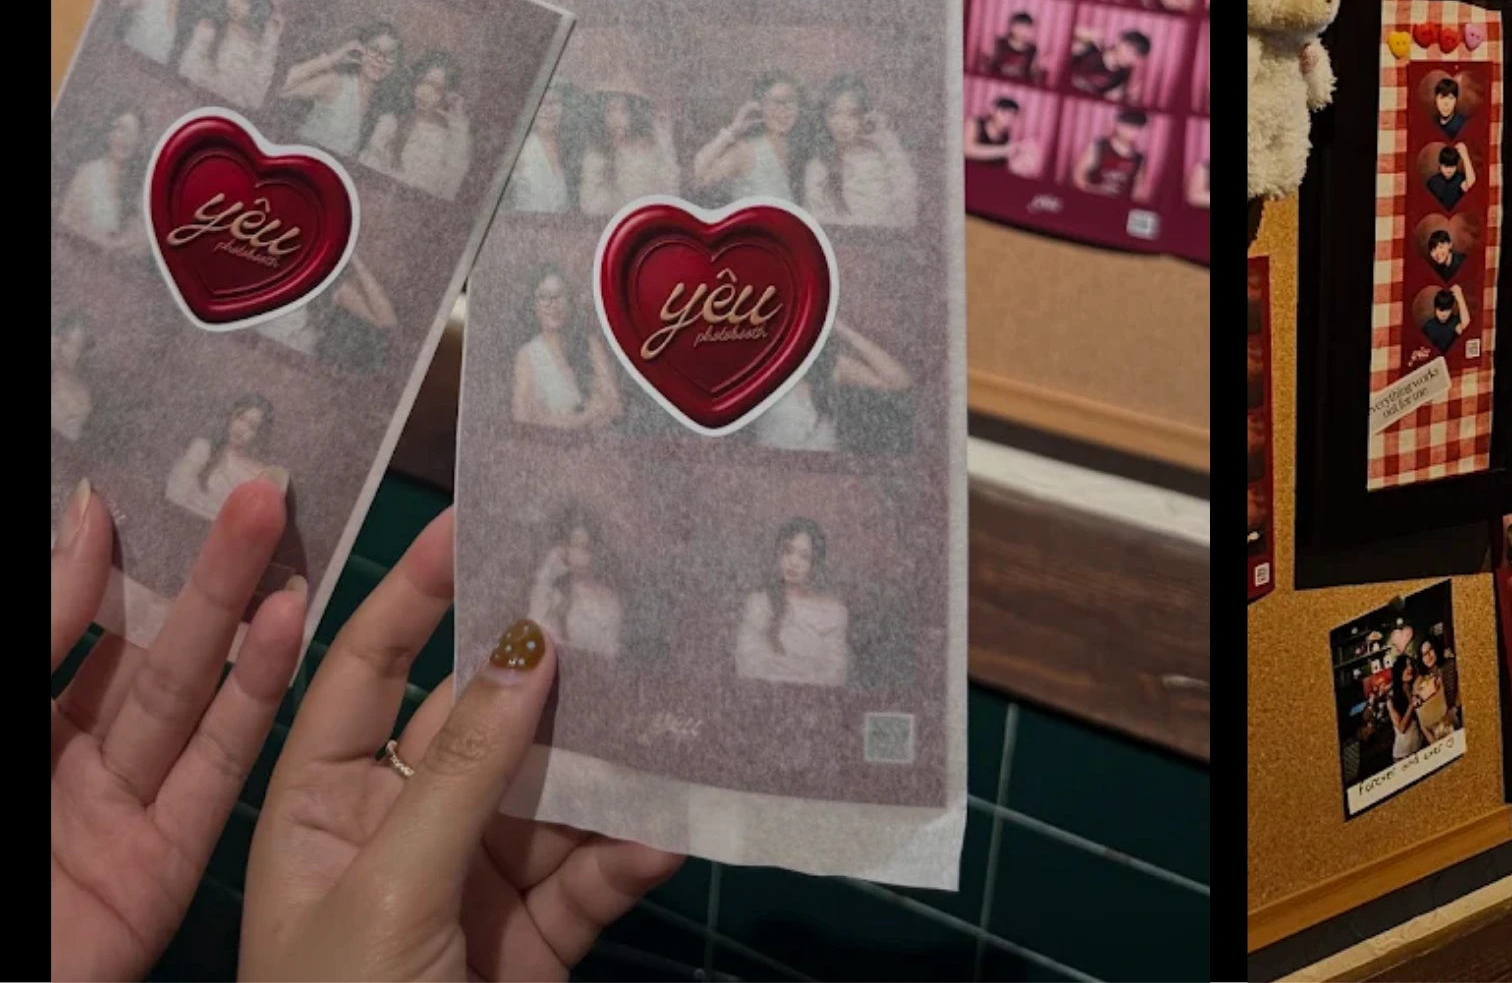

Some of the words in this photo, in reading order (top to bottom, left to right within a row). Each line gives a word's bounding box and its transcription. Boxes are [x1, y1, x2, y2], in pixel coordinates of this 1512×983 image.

[167, 193, 301, 255] yêu
[640, 268, 783, 359] yêu
[694, 325, 769, 347] photobooth
[1369, 383, 1414, 413] verything
